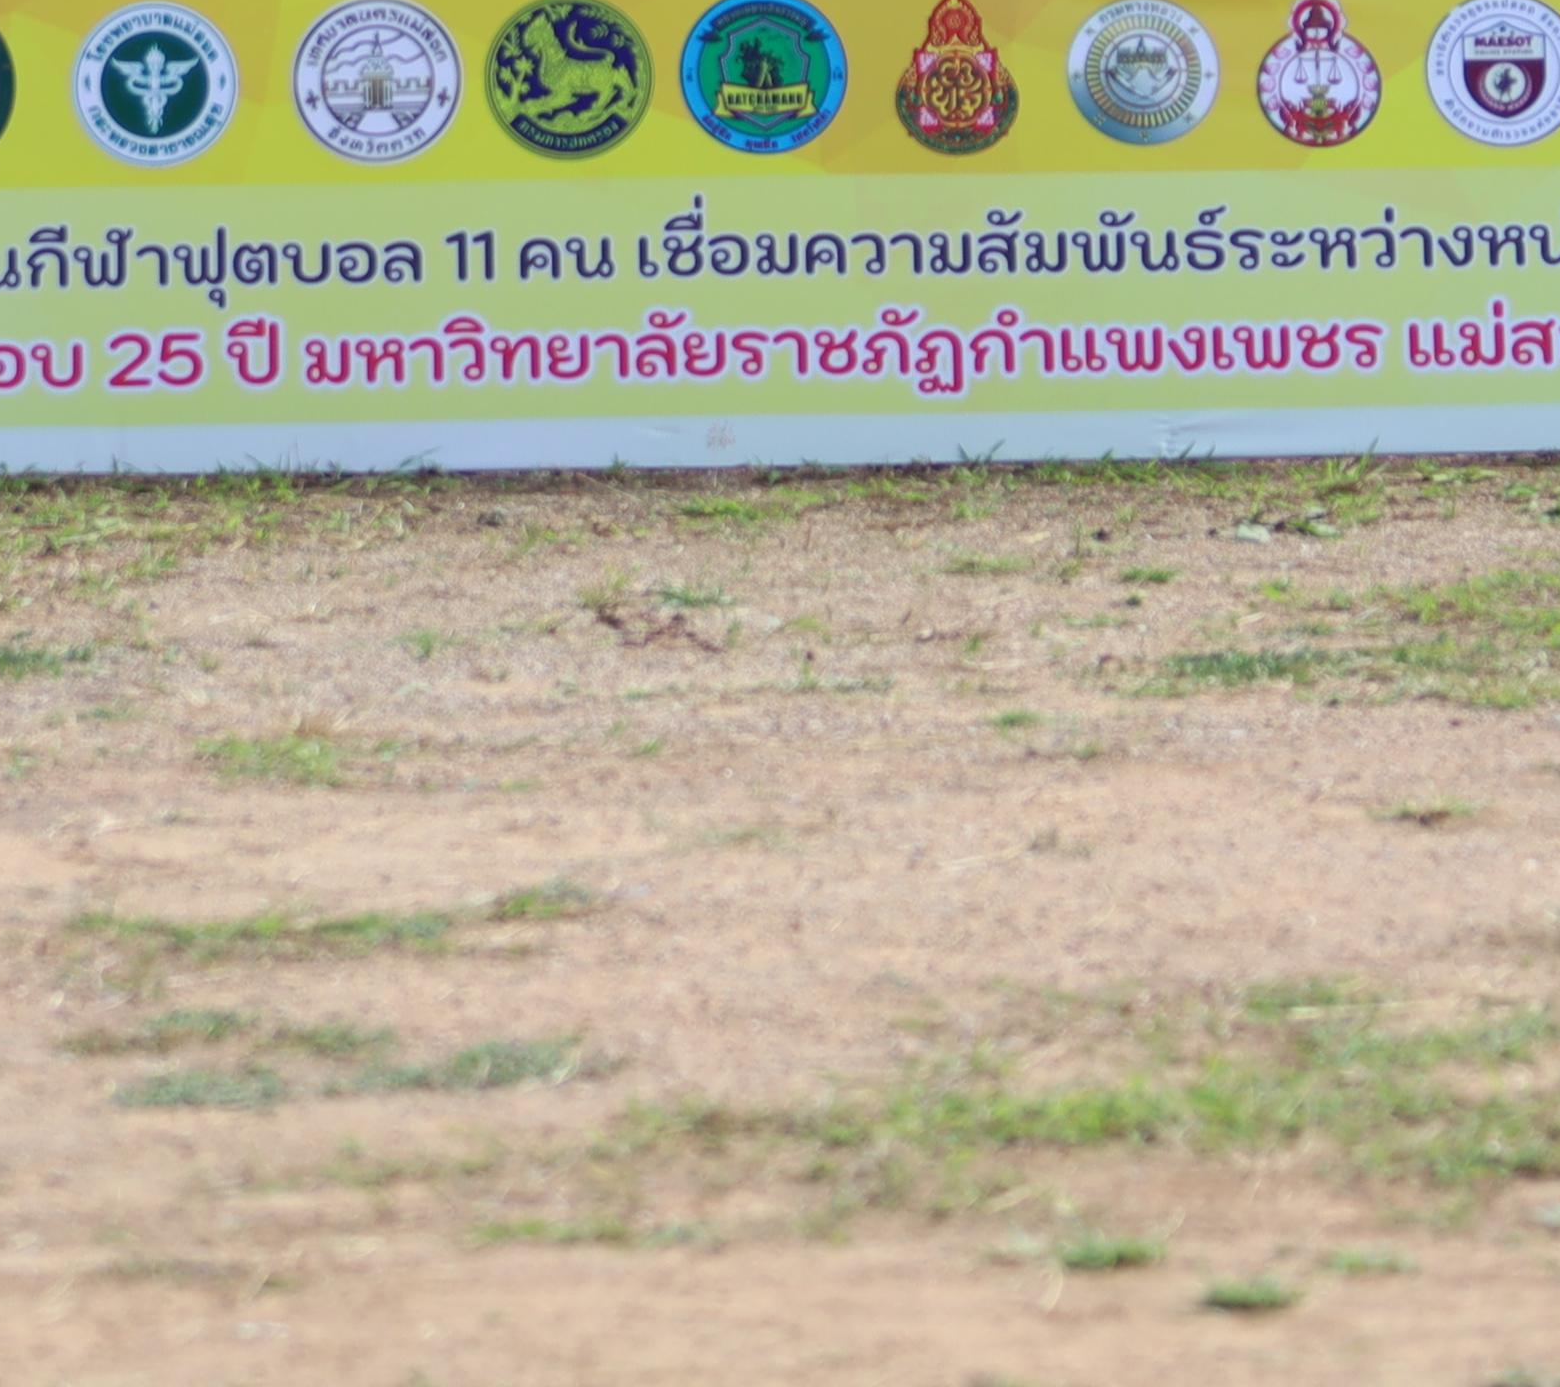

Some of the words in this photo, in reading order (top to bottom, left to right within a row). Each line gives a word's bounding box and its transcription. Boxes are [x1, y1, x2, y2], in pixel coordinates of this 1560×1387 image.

[446, 230, 495, 281] 11
[518, 237, 614, 281] คน
[107, 331, 204, 390] 25
[225, 318, 281, 389] ปี
[304, 306, 1382, 395] มหาวิทยาลัยราชภัฏกำแพงเพชร
